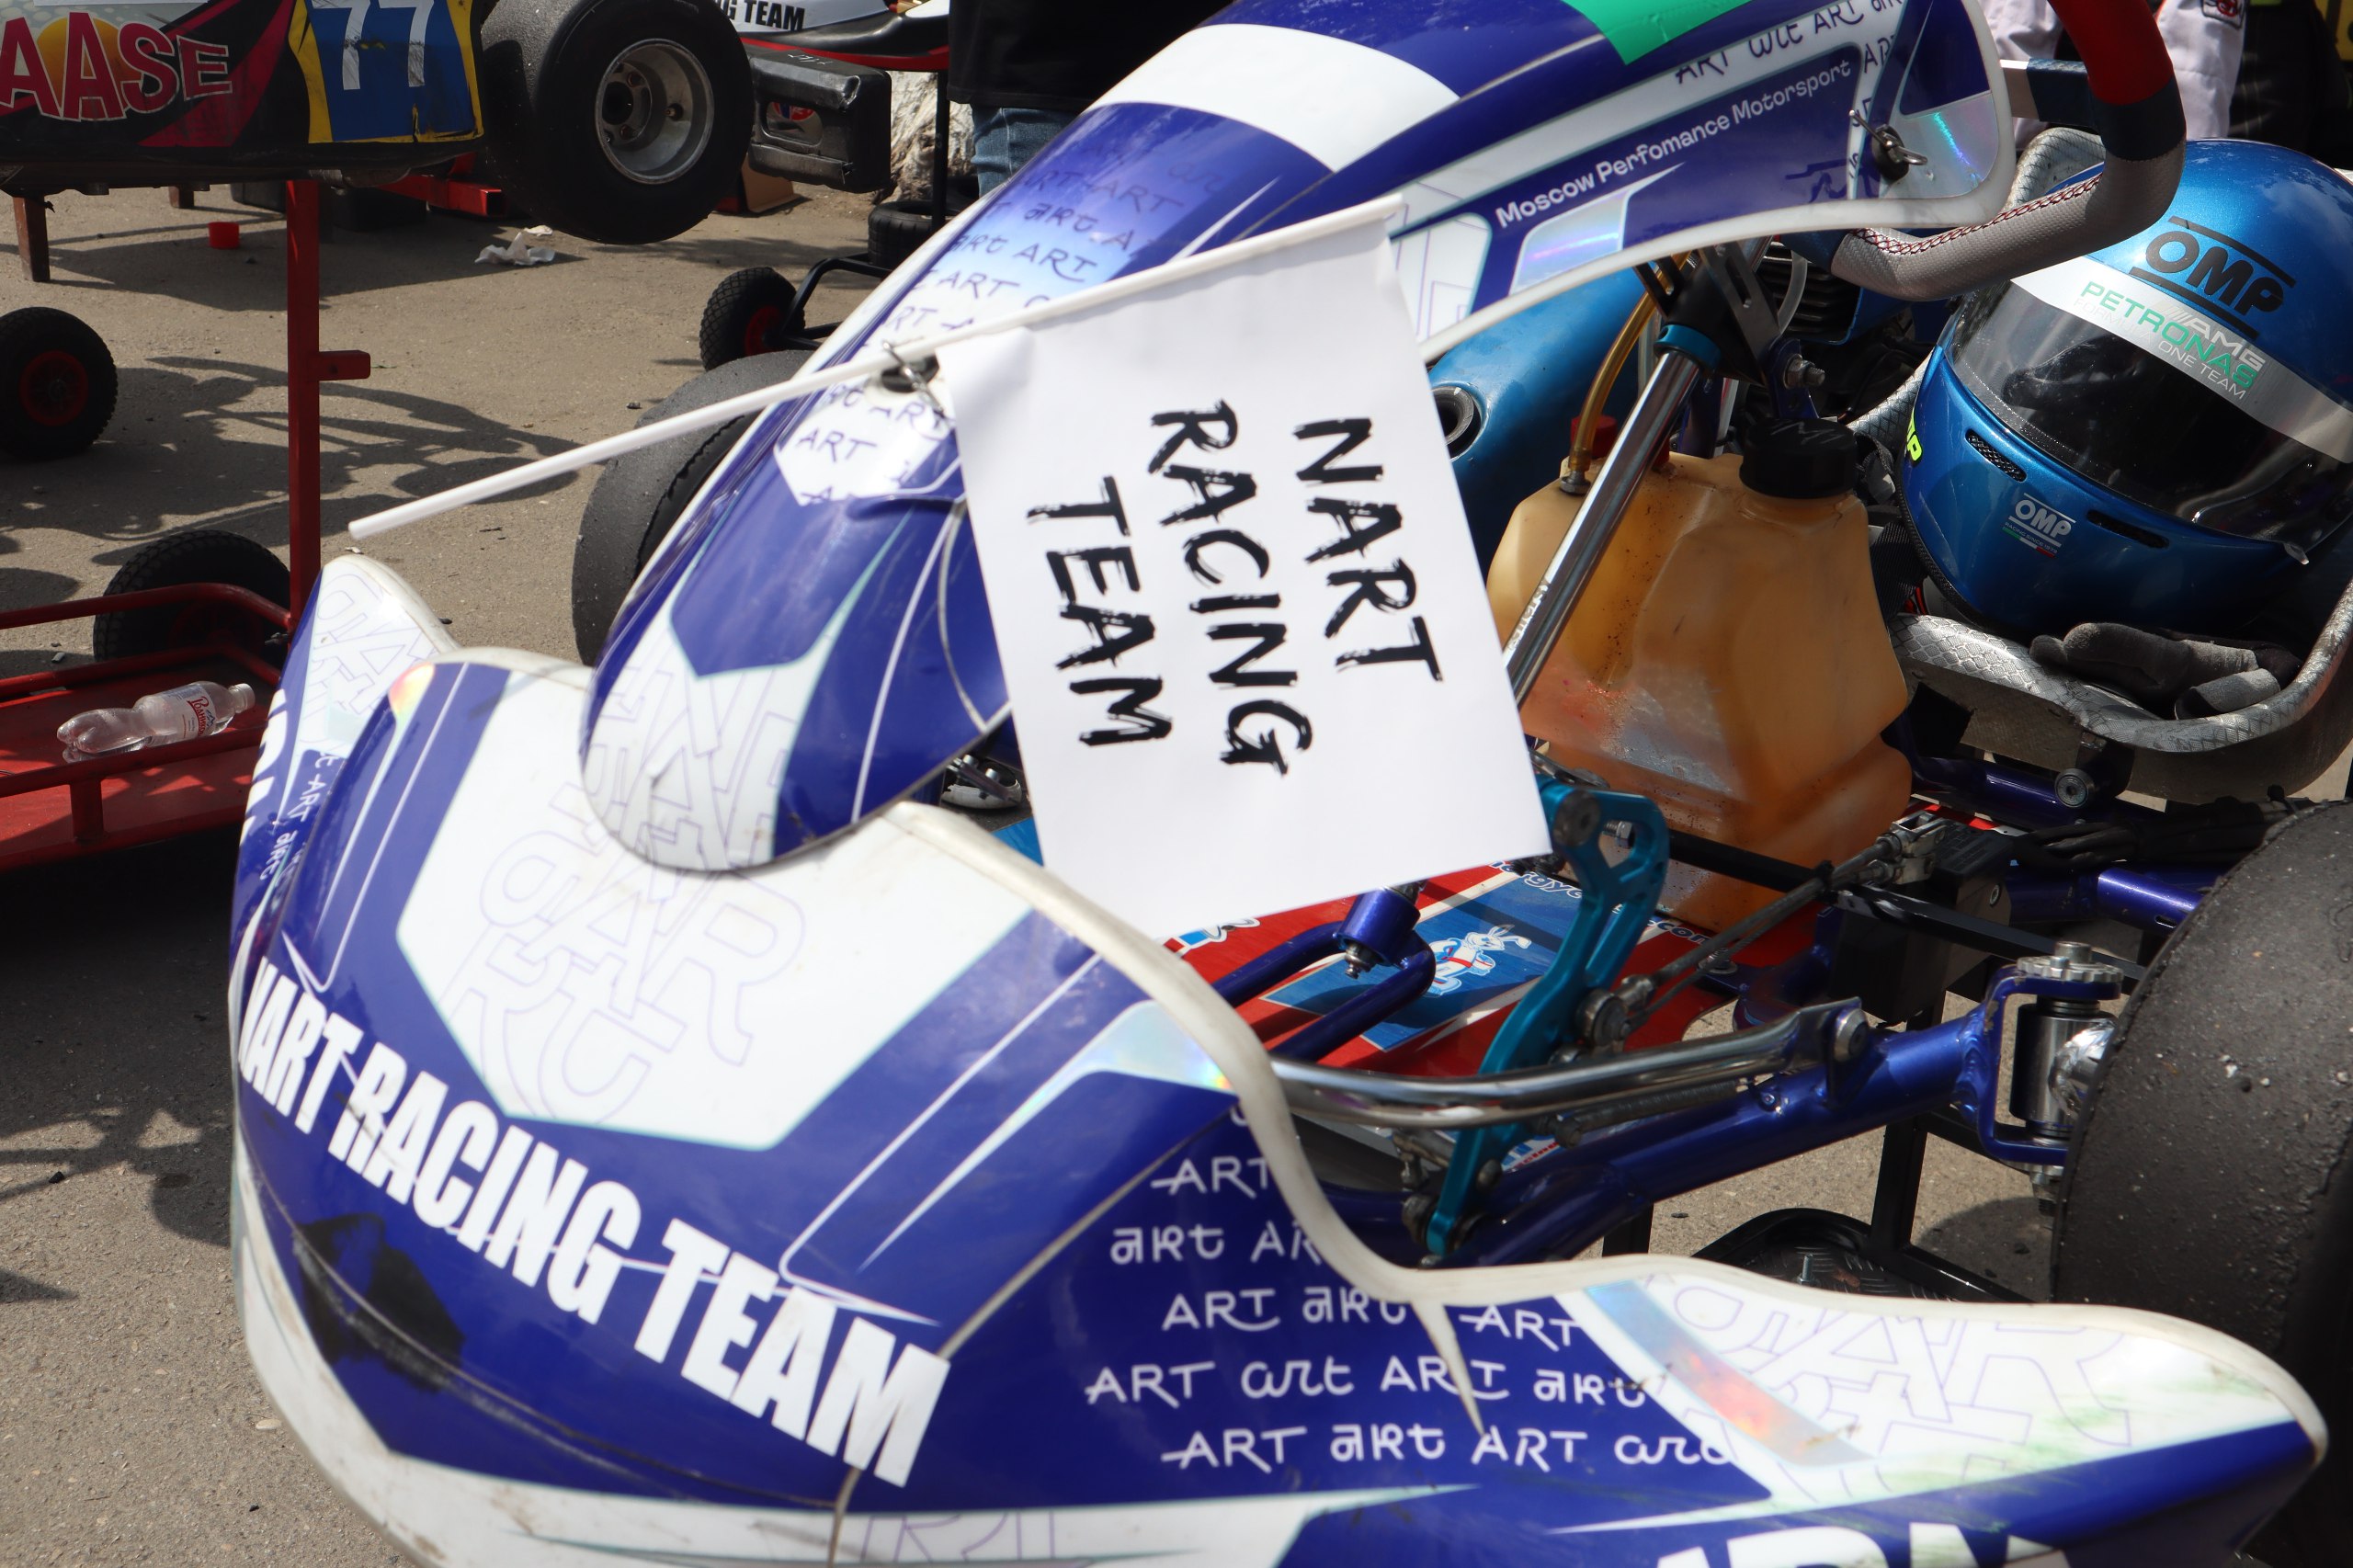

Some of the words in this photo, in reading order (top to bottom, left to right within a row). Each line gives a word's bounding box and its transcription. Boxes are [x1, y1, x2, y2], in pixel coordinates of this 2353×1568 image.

[312, 0, 435, 90] 77
[745, 0, 805, 31] TEAM
[1495, 172, 1596, 229] Moscow
[1596, 113, 1731, 184] Perfomance
[1732, 60, 1852, 125] Motorsport
[937, 270, 1021, 300] ART
[1013, 243, 1098, 282] ART
[2145, 230, 2284, 317] OMP
[2080, 280, 2260, 389] PETRONAS
[2184, 316, 2266, 373] AMG
[2158, 340, 2199, 368] ONE
[2200, 362, 2247, 401] TEAM
[794, 427, 878, 463] ART
[1292, 417, 1444, 683] NART
[2015, 499, 2072, 539] OMP
[1025, 474, 1173, 747] TEAM
[1147, 398, 1314, 778] RACING
[327, 1041, 642, 1325] RACING
[633, 1218, 951, 1489] TEAM
[1161, 1289, 1281, 1332] ART
[1459, 1303, 1581, 1352] ART
[1084, 1360, 1216, 1409] ART
[1380, 1355, 1510, 1401] ART
[1160, 1426, 1308, 1474] ART
[1471, 1425, 1588, 1472] ART
